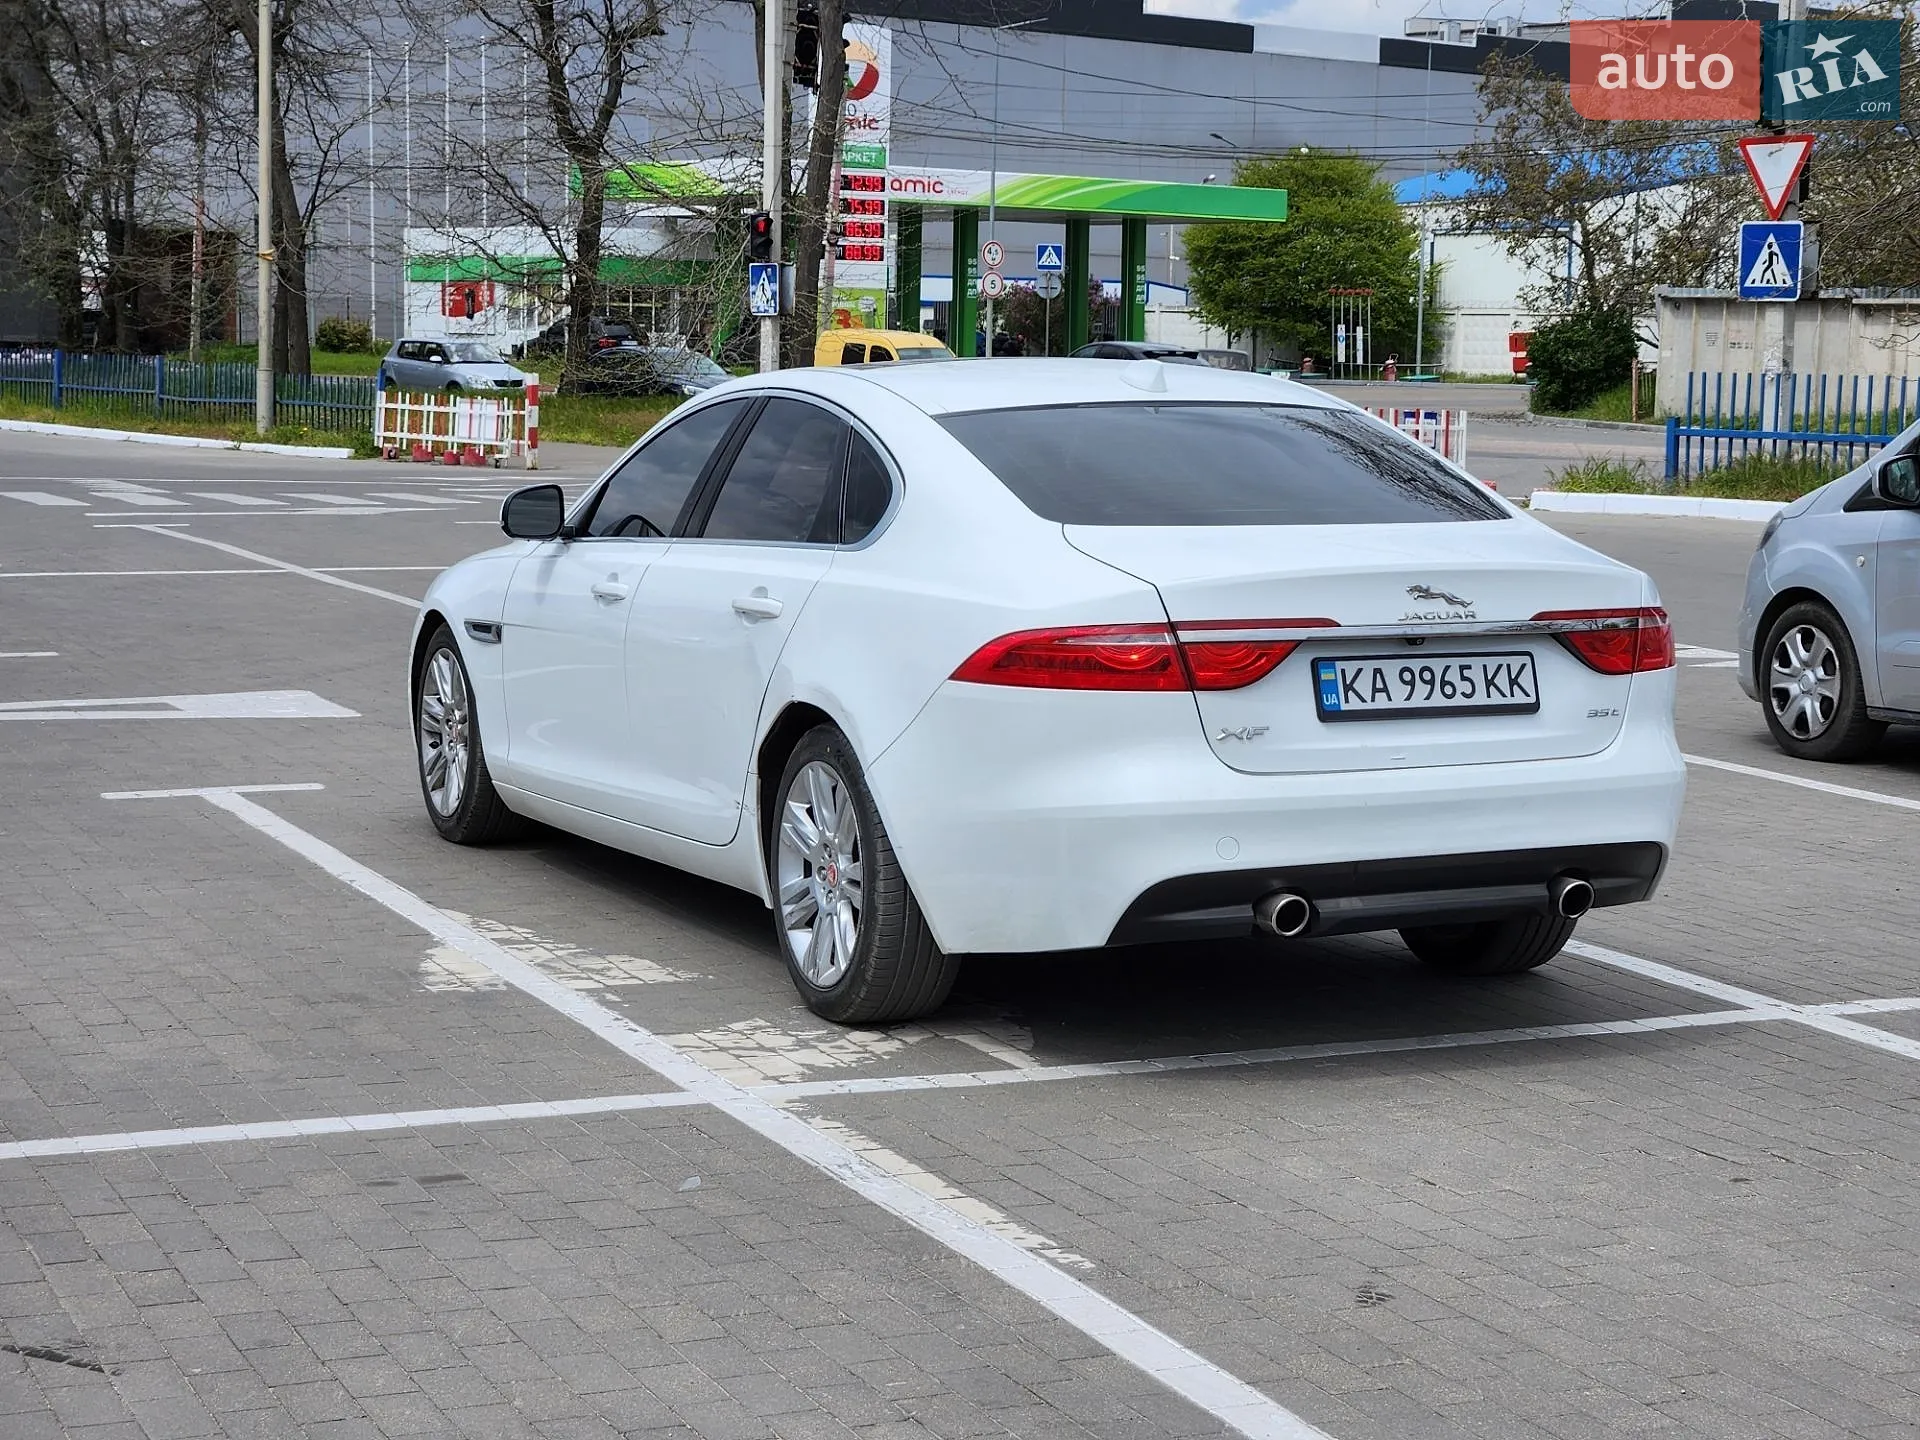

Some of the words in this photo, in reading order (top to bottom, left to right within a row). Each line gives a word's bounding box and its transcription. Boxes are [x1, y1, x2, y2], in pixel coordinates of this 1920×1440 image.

[842, 151, 876, 163] АРКЕТ
[890, 175, 944, 194] amic
[1398, 611, 1476, 621] JAGUAR
[1341, 667, 1393, 704] KA
[1398, 664, 1476, 701] 9965
[1482, 662, 1531, 698] KK
[1323, 693, 1339, 705] UA
[1586, 708, 1620, 718] 35t
[1216, 726, 1270, 741] XF
